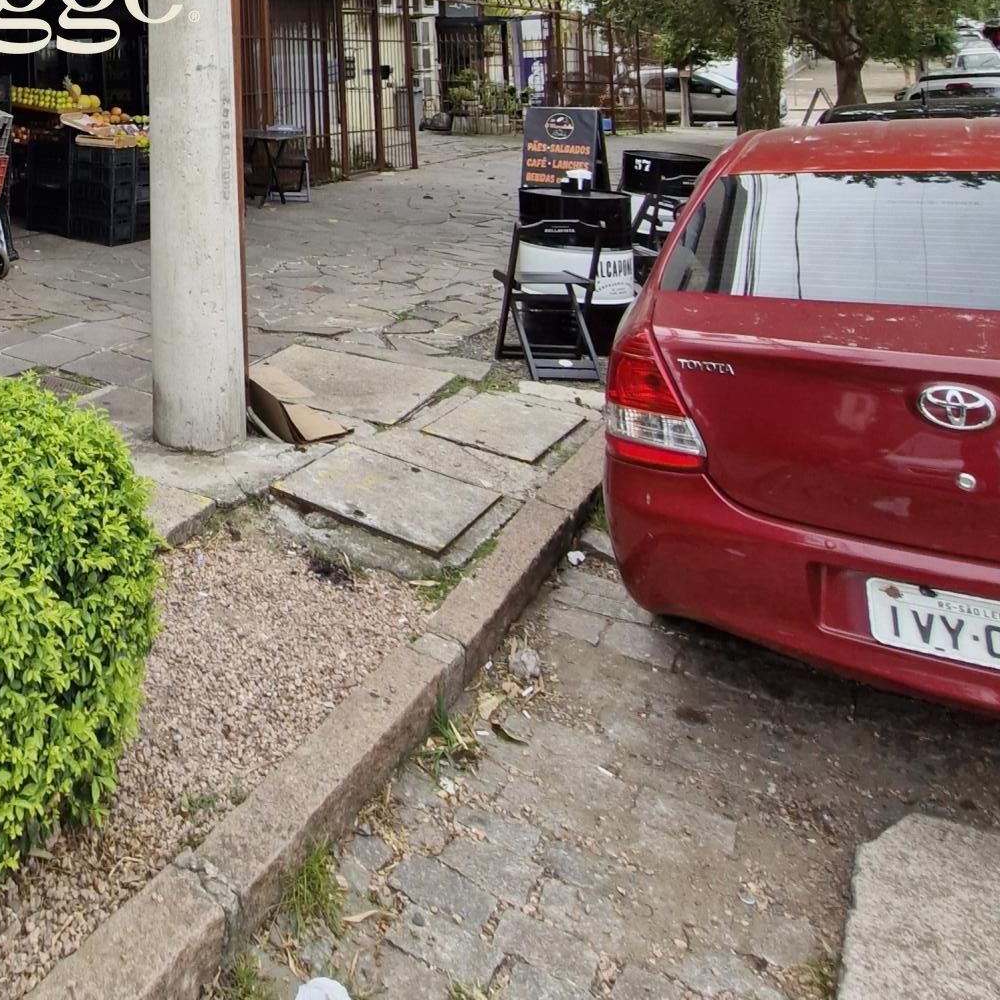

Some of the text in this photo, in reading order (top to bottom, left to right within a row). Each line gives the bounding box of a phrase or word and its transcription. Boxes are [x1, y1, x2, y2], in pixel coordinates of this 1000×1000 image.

[527, 140, 591, 155] PÃES SALGADOS
[526, 156, 590, 171] CAFÉ LANCHES
[634, 158, 652, 172] 57
[526, 172, 555, 184] BEBIDAS
[677, 358, 735, 375] TOYOTA
[983, 608, 1000, 621] LE
